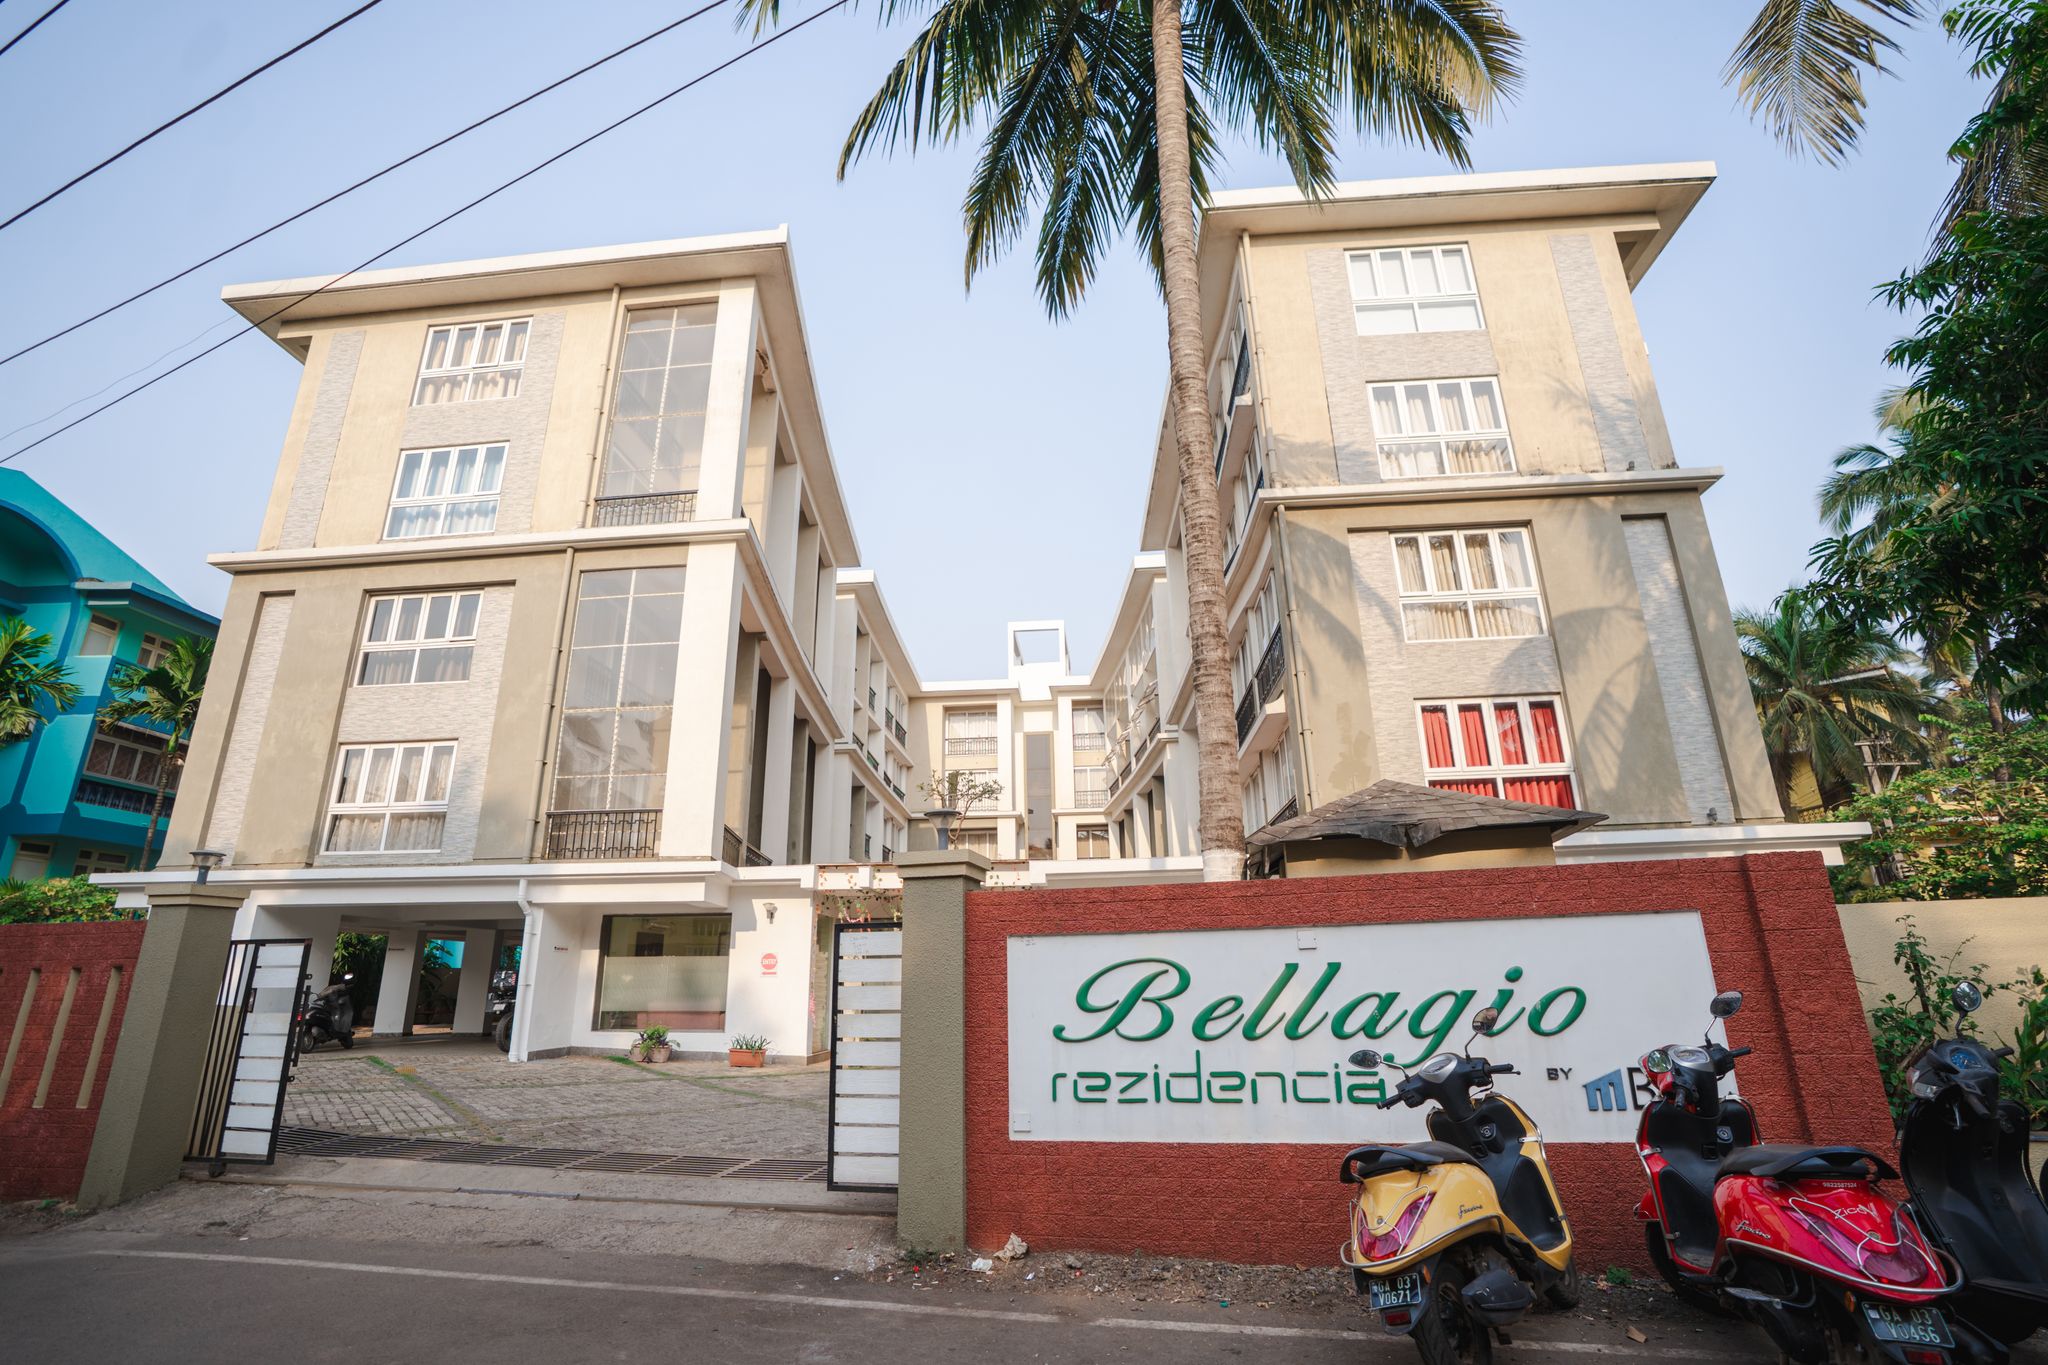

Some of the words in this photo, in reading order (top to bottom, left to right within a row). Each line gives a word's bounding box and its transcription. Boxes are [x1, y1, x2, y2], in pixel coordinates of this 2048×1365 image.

[1052, 957, 1587, 1068] Bellagio
[1052, 1049, 1387, 1104] rezidencia
[1546, 1067, 1573, 1081] BY
[1378, 1279, 1391, 1293] GA
[1397, 1275, 1411, 1290] 03
[1379, 1289, 1411, 1306] V0671
[1879, 1305, 1902, 1322] GA
[1909, 1308, 1932, 1325] 03
[1886, 1321, 1941, 1344] V0456
